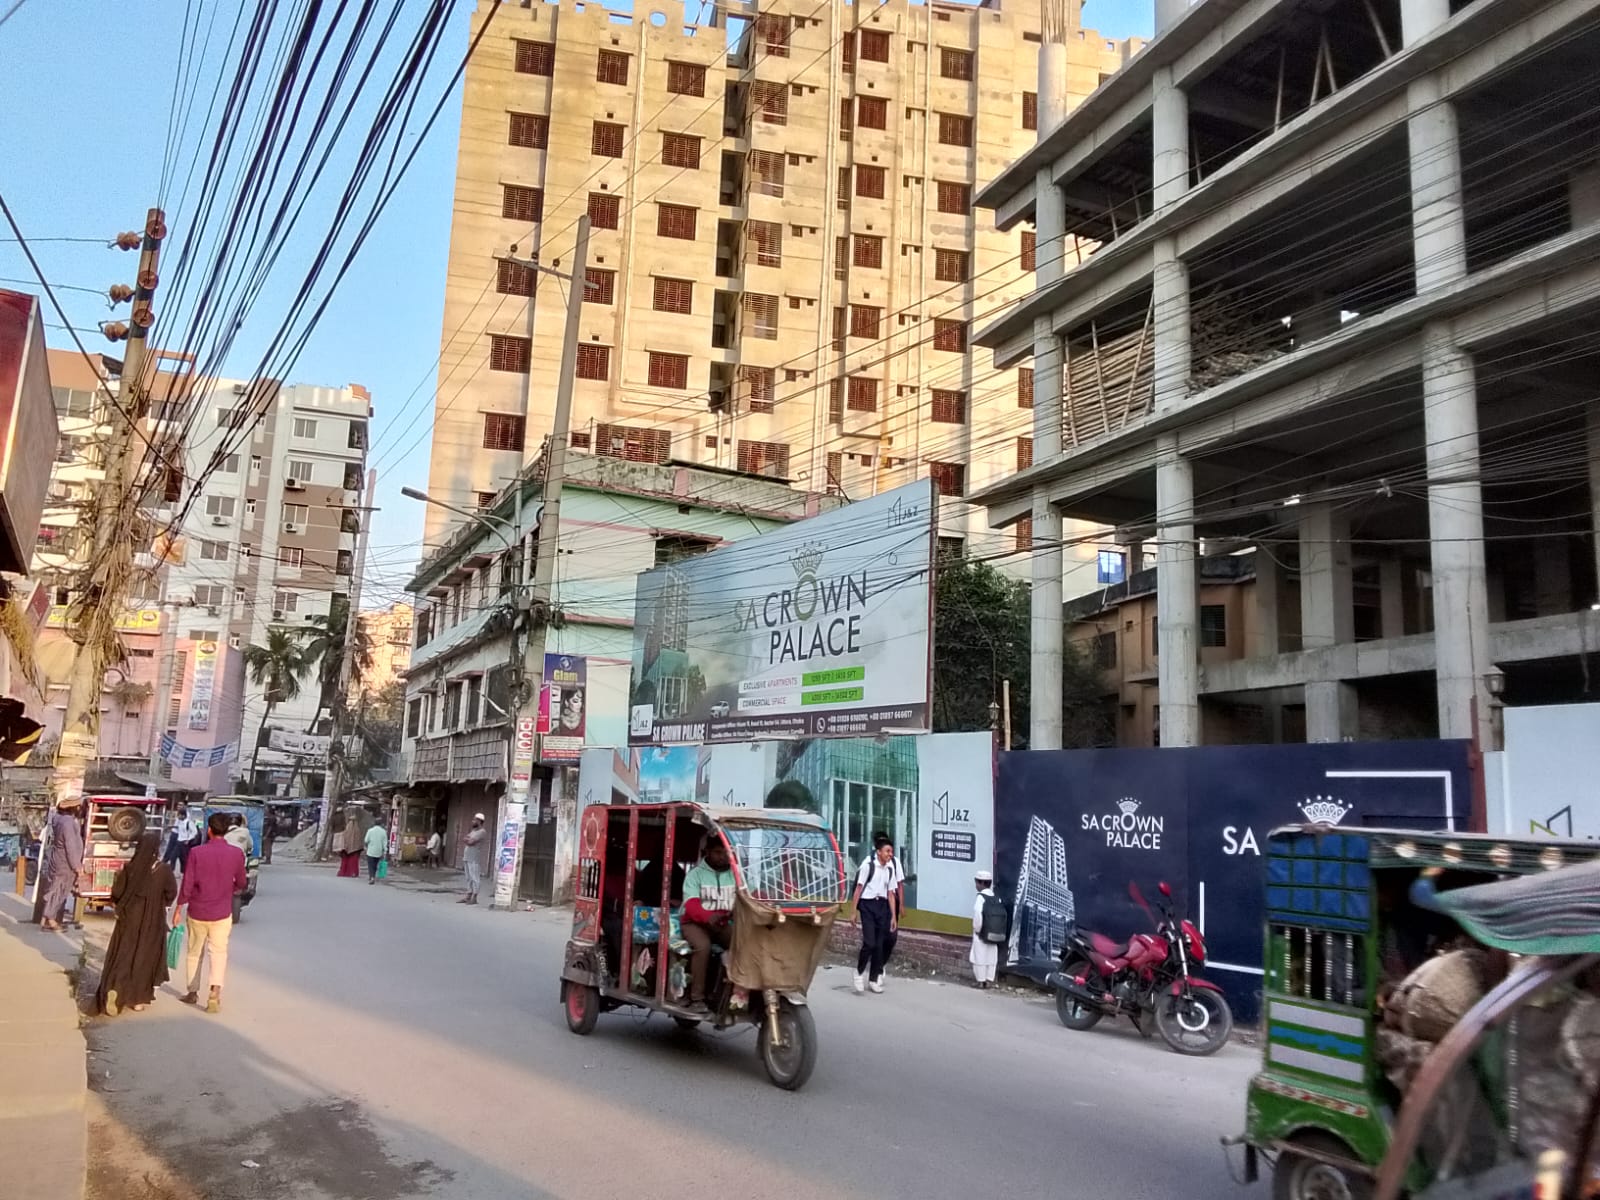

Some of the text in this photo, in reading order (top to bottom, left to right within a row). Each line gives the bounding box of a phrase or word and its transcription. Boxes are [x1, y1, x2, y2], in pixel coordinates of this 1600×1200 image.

[733, 570, 867, 633] SA CROWN
[769, 614, 861, 665] PALACE
[553, 669, 578, 681] Glam
[743, 677, 798, 691] EXCLUSIVE APARTMENTS
[742, 696, 787, 708] COMMERCIAL SPACE
[652, 725, 661, 742] SA
[660, 724, 682, 742] CROWN
[682, 723, 705, 741] PALACE
[950, 808, 970, 822] J&Z
[1081, 811, 1164, 833] SA CROWN
[1106, 831, 1161, 850] PALACE
[1222, 825, 1261, 856] SA
